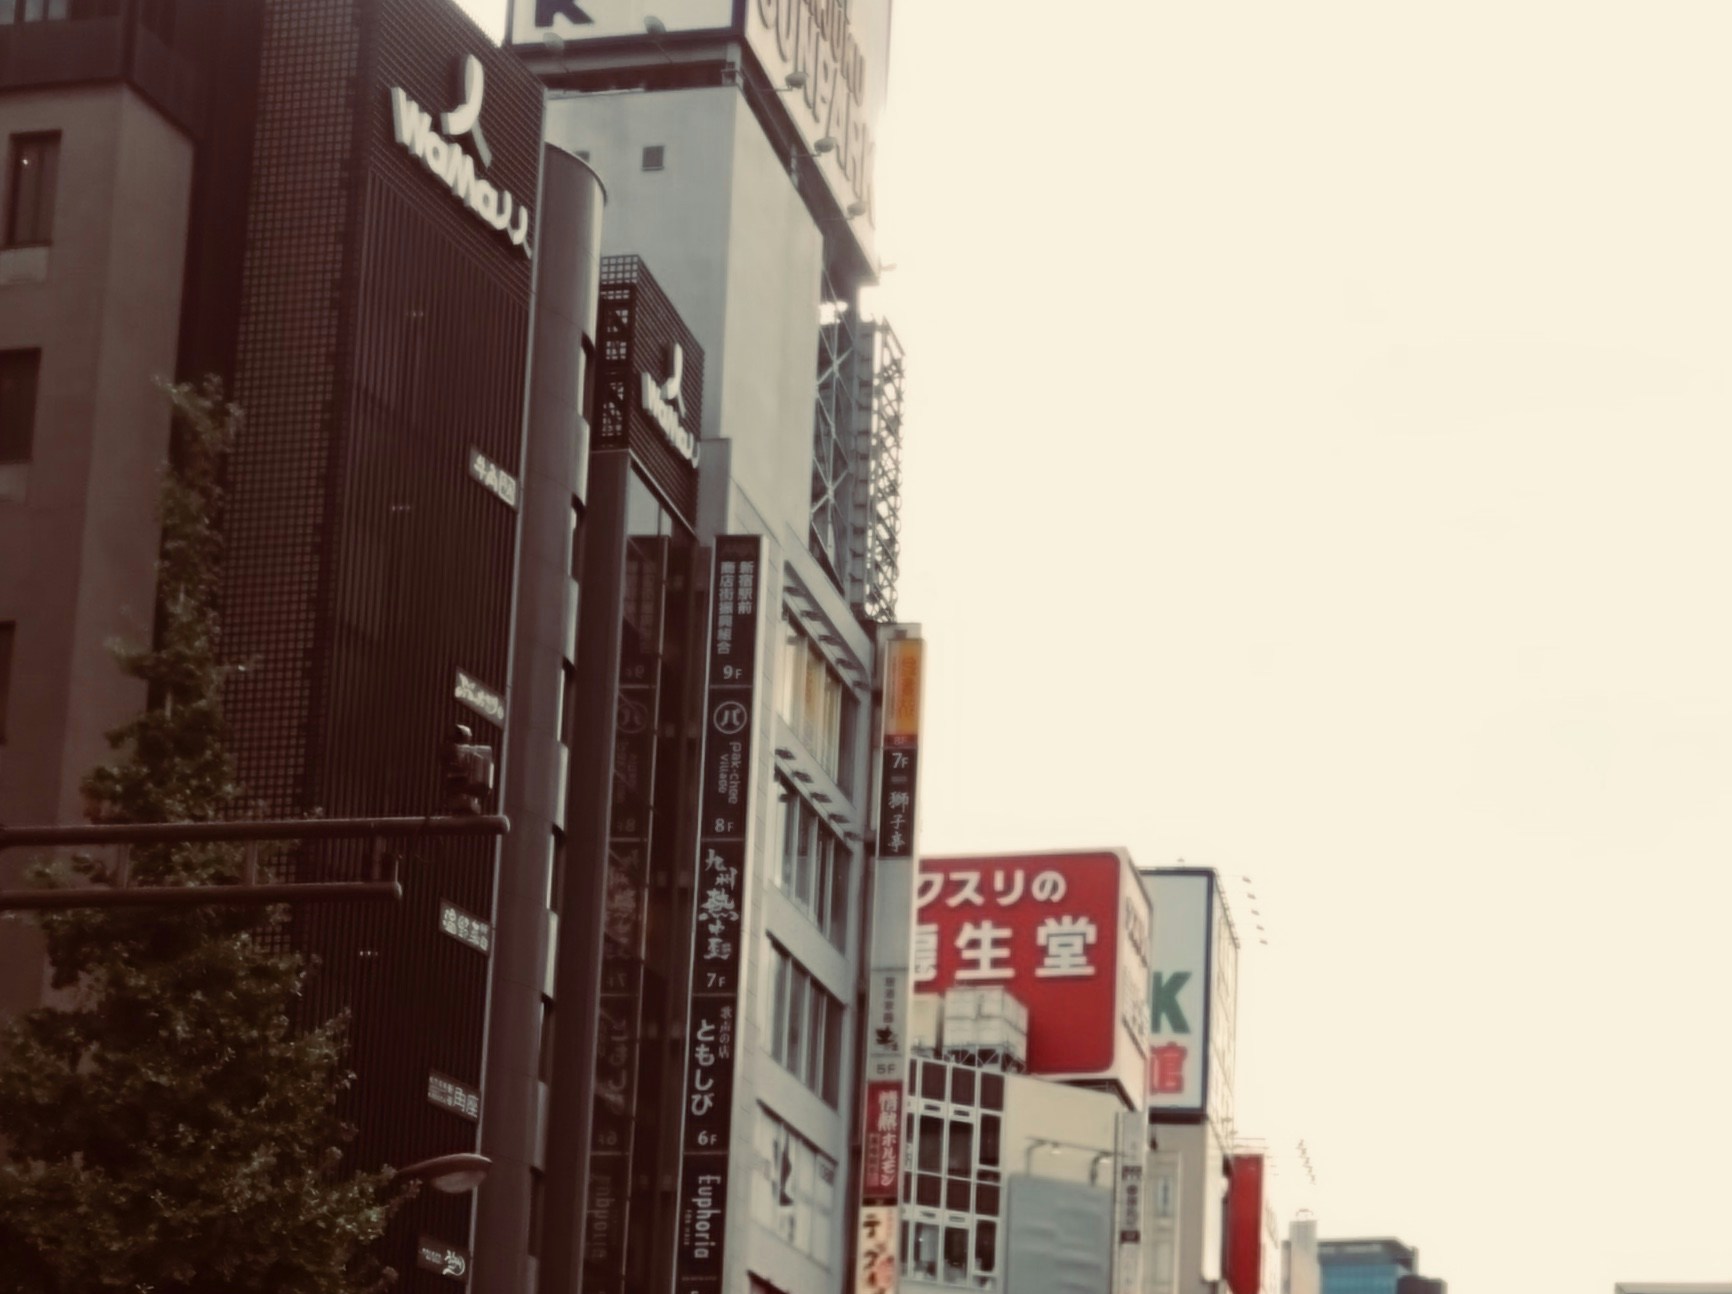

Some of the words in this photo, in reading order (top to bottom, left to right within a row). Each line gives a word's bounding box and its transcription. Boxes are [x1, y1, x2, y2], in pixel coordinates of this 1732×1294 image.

[722, 664, 743, 681] 9F
[891, 752, 909, 769] 7F
[714, 817, 735, 833] 8F
[706, 972, 727, 988] 7F
[691, 1018, 717, 1116] ともしび
[697, 1130, 718, 1147] 6F
[692, 1174, 722, 1259] Euphoria
